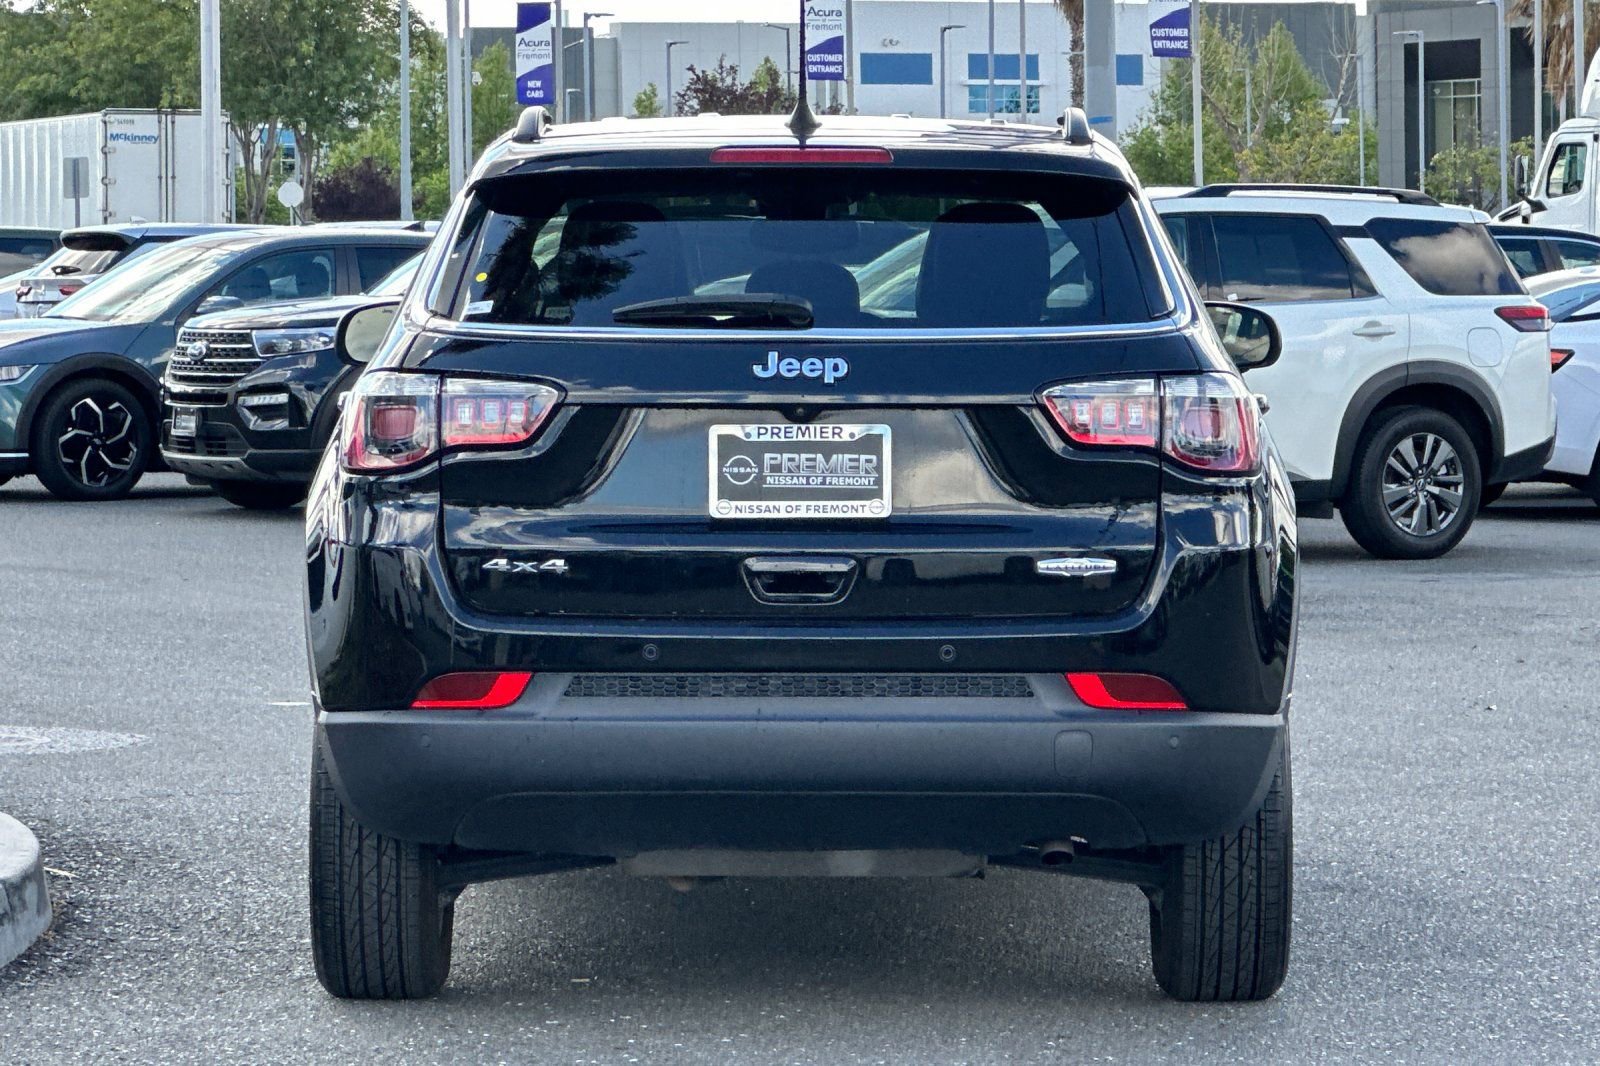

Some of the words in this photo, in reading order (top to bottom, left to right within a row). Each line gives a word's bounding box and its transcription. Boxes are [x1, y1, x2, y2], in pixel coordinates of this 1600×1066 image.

[807, 6, 842, 17] Acura
[807, 23, 842, 31] Fremont
[1151, 28, 1189, 37] CUSTOMER
[518, 37, 550, 47] Acura
[1153, 40, 1189, 49] ENTRANCE
[517, 52, 550, 60] Fremont
[807, 53, 843, 62] CUSTOMER
[808, 65, 843, 73] ENTRANCE
[527, 80, 541, 88] NEW
[526, 90, 544, 98] CARS
[752, 351, 848, 383] Jeep
[757, 426, 843, 439] PREMIER
[763, 453, 877, 475] PREMIER
[766, 476, 807, 485] NISSAN
[809, 477, 823, 485] OF
[826, 477, 875, 486] FREMONT
[734, 504, 780, 514] NISSAN
[785, 504, 801, 514] OF
[806, 504, 867, 514] FREMONT
[482, 559, 569, 574] 4x4
